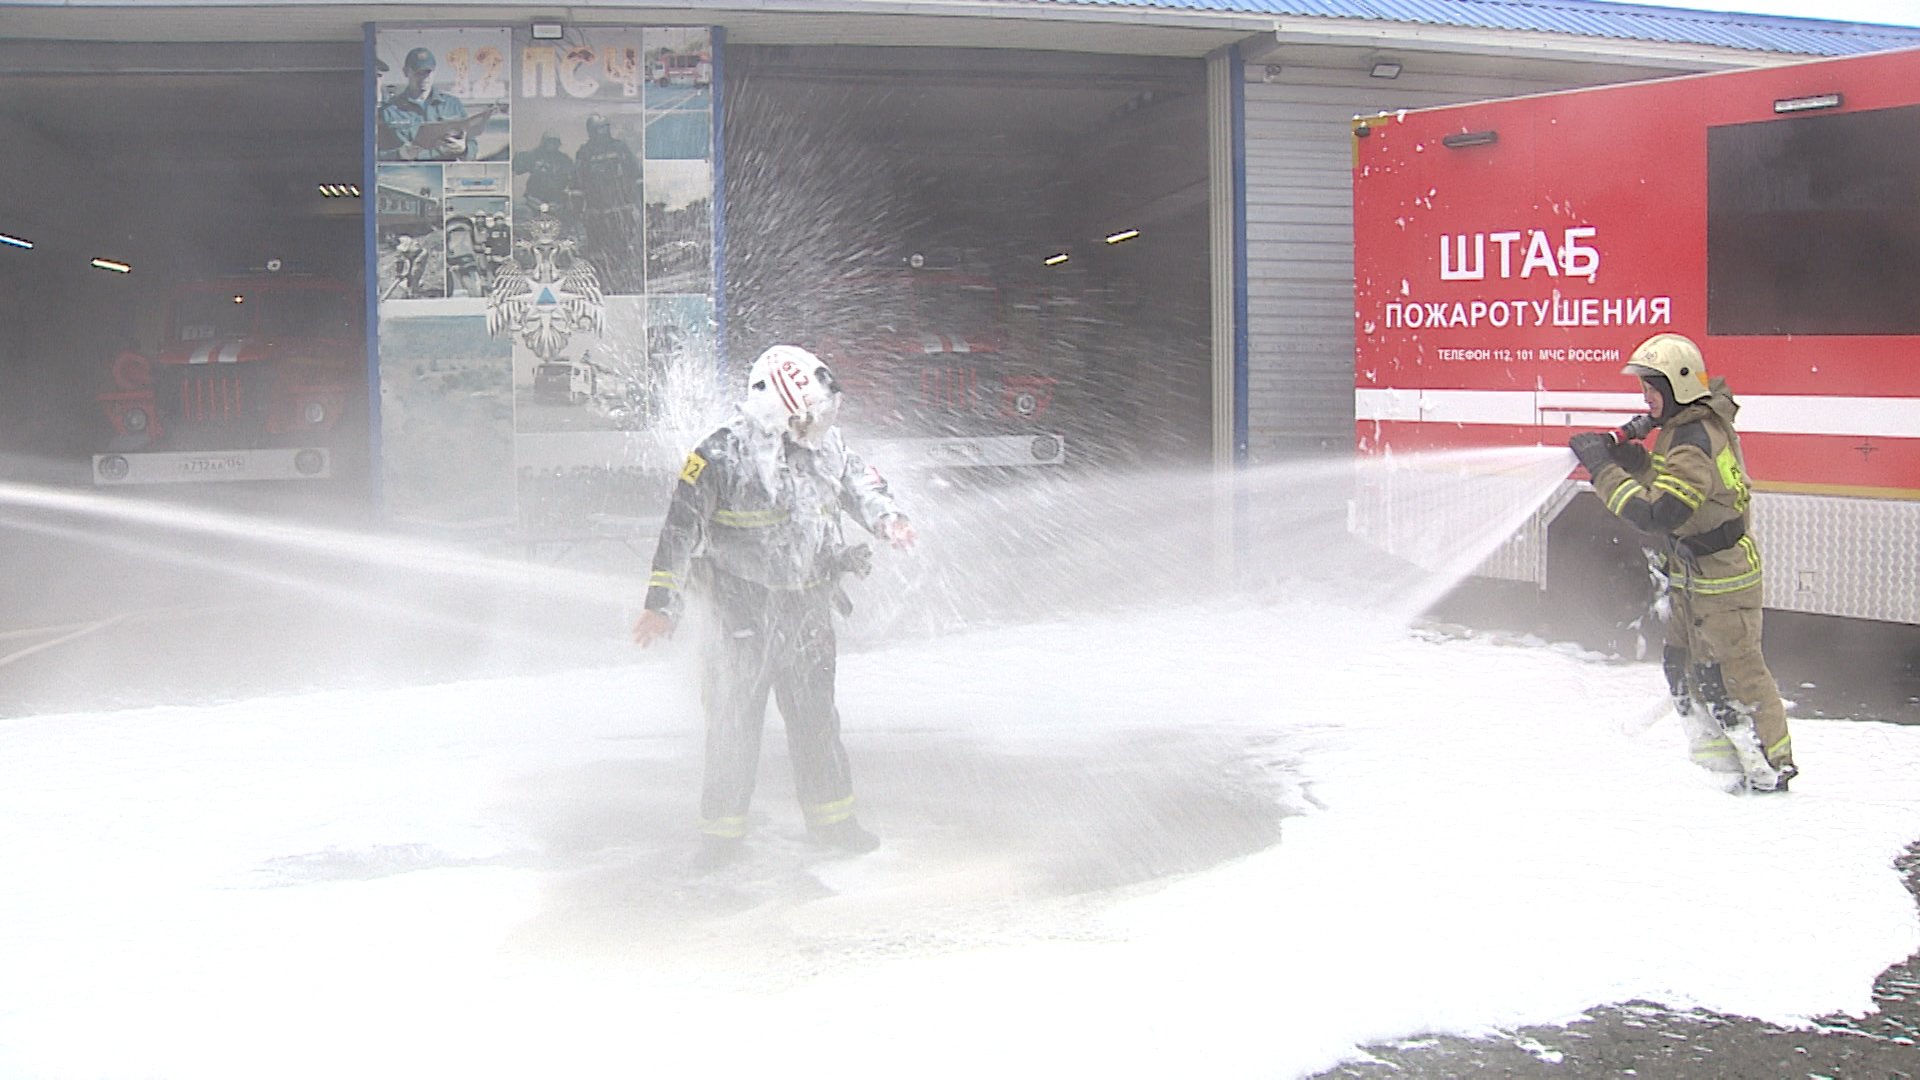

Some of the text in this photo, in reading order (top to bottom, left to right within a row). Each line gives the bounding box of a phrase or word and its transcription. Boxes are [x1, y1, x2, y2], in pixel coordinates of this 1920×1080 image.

[446, 45, 638, 98] 12 ПСЧ
[1440, 227, 1600, 281] ШТАБ
[1385, 297, 1672, 328] ПОЖАРОТУШЕНИЯ
[1438, 348, 1490, 360] ТЕЛЕФОН
[1516, 349, 1534, 360] 101
[1538, 348, 1566, 360] МЧС
[1568, 348, 1620, 361] РОССИИ
[781, 360, 810, 390] 612
